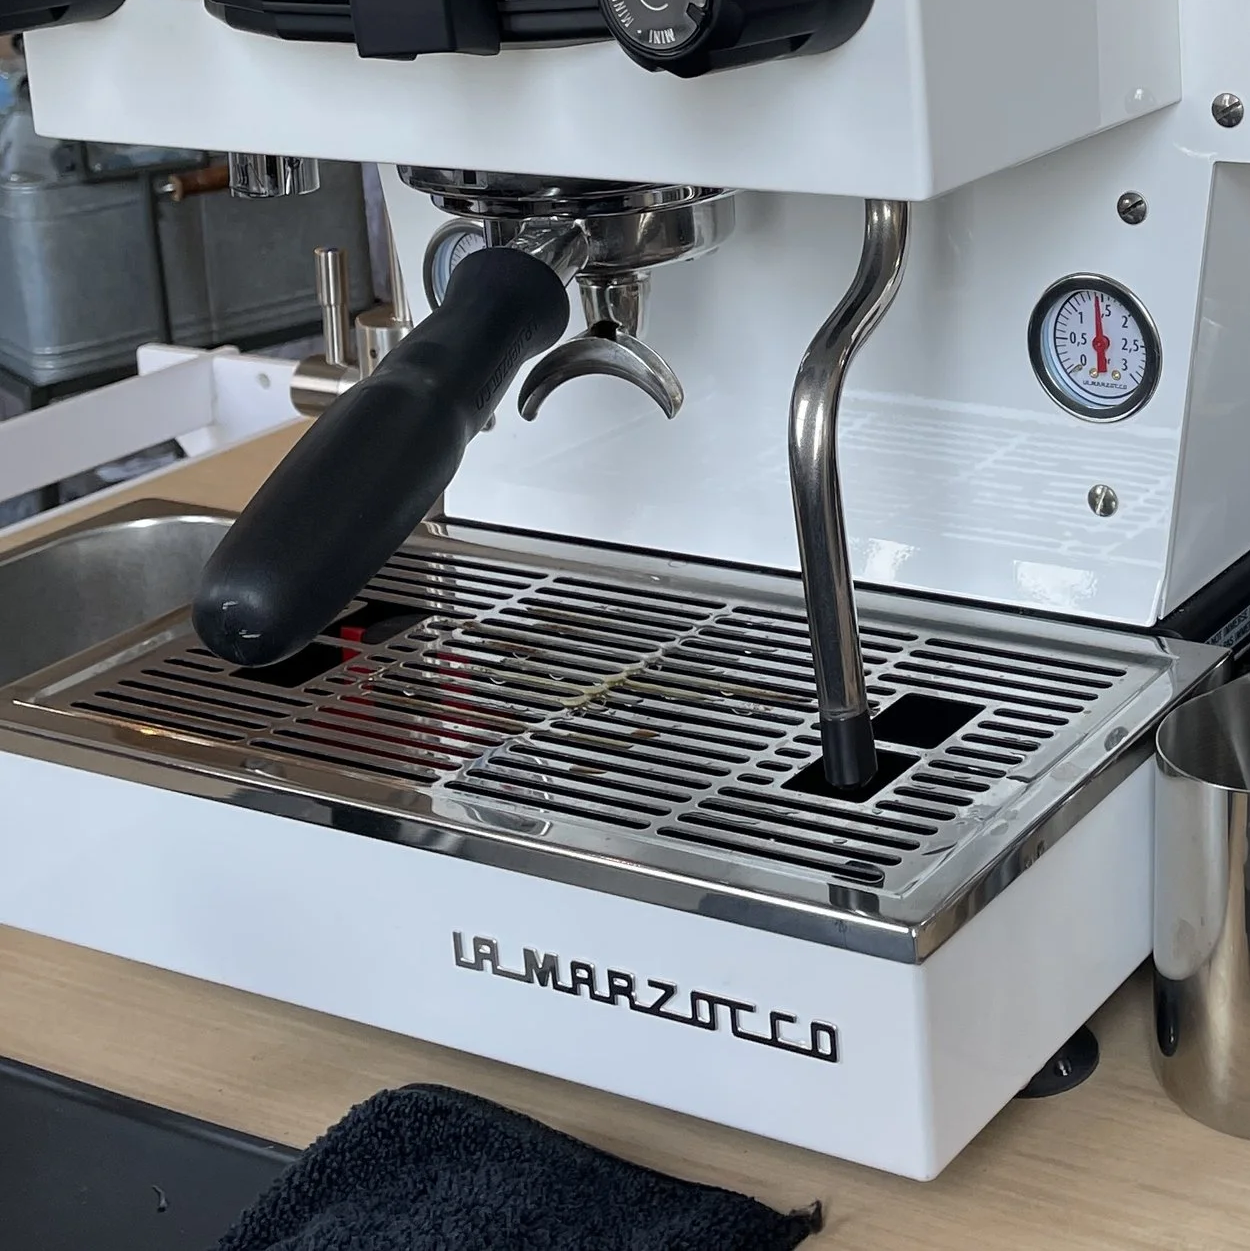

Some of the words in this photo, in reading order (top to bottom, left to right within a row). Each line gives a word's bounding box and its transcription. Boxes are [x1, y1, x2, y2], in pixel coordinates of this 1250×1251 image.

[649, 28, 675, 44] MINI
[1078, 312, 1083, 324] 1
[1121, 316, 1128, 329] 2
[1069, 332, 1087, 347] 0,5
[1121, 338, 1139, 353] 2,5
[1080, 354, 1087, 367] 0
[1121, 359, 1128, 371] 3
[522, 946, 840, 1064] MARZOCCO
